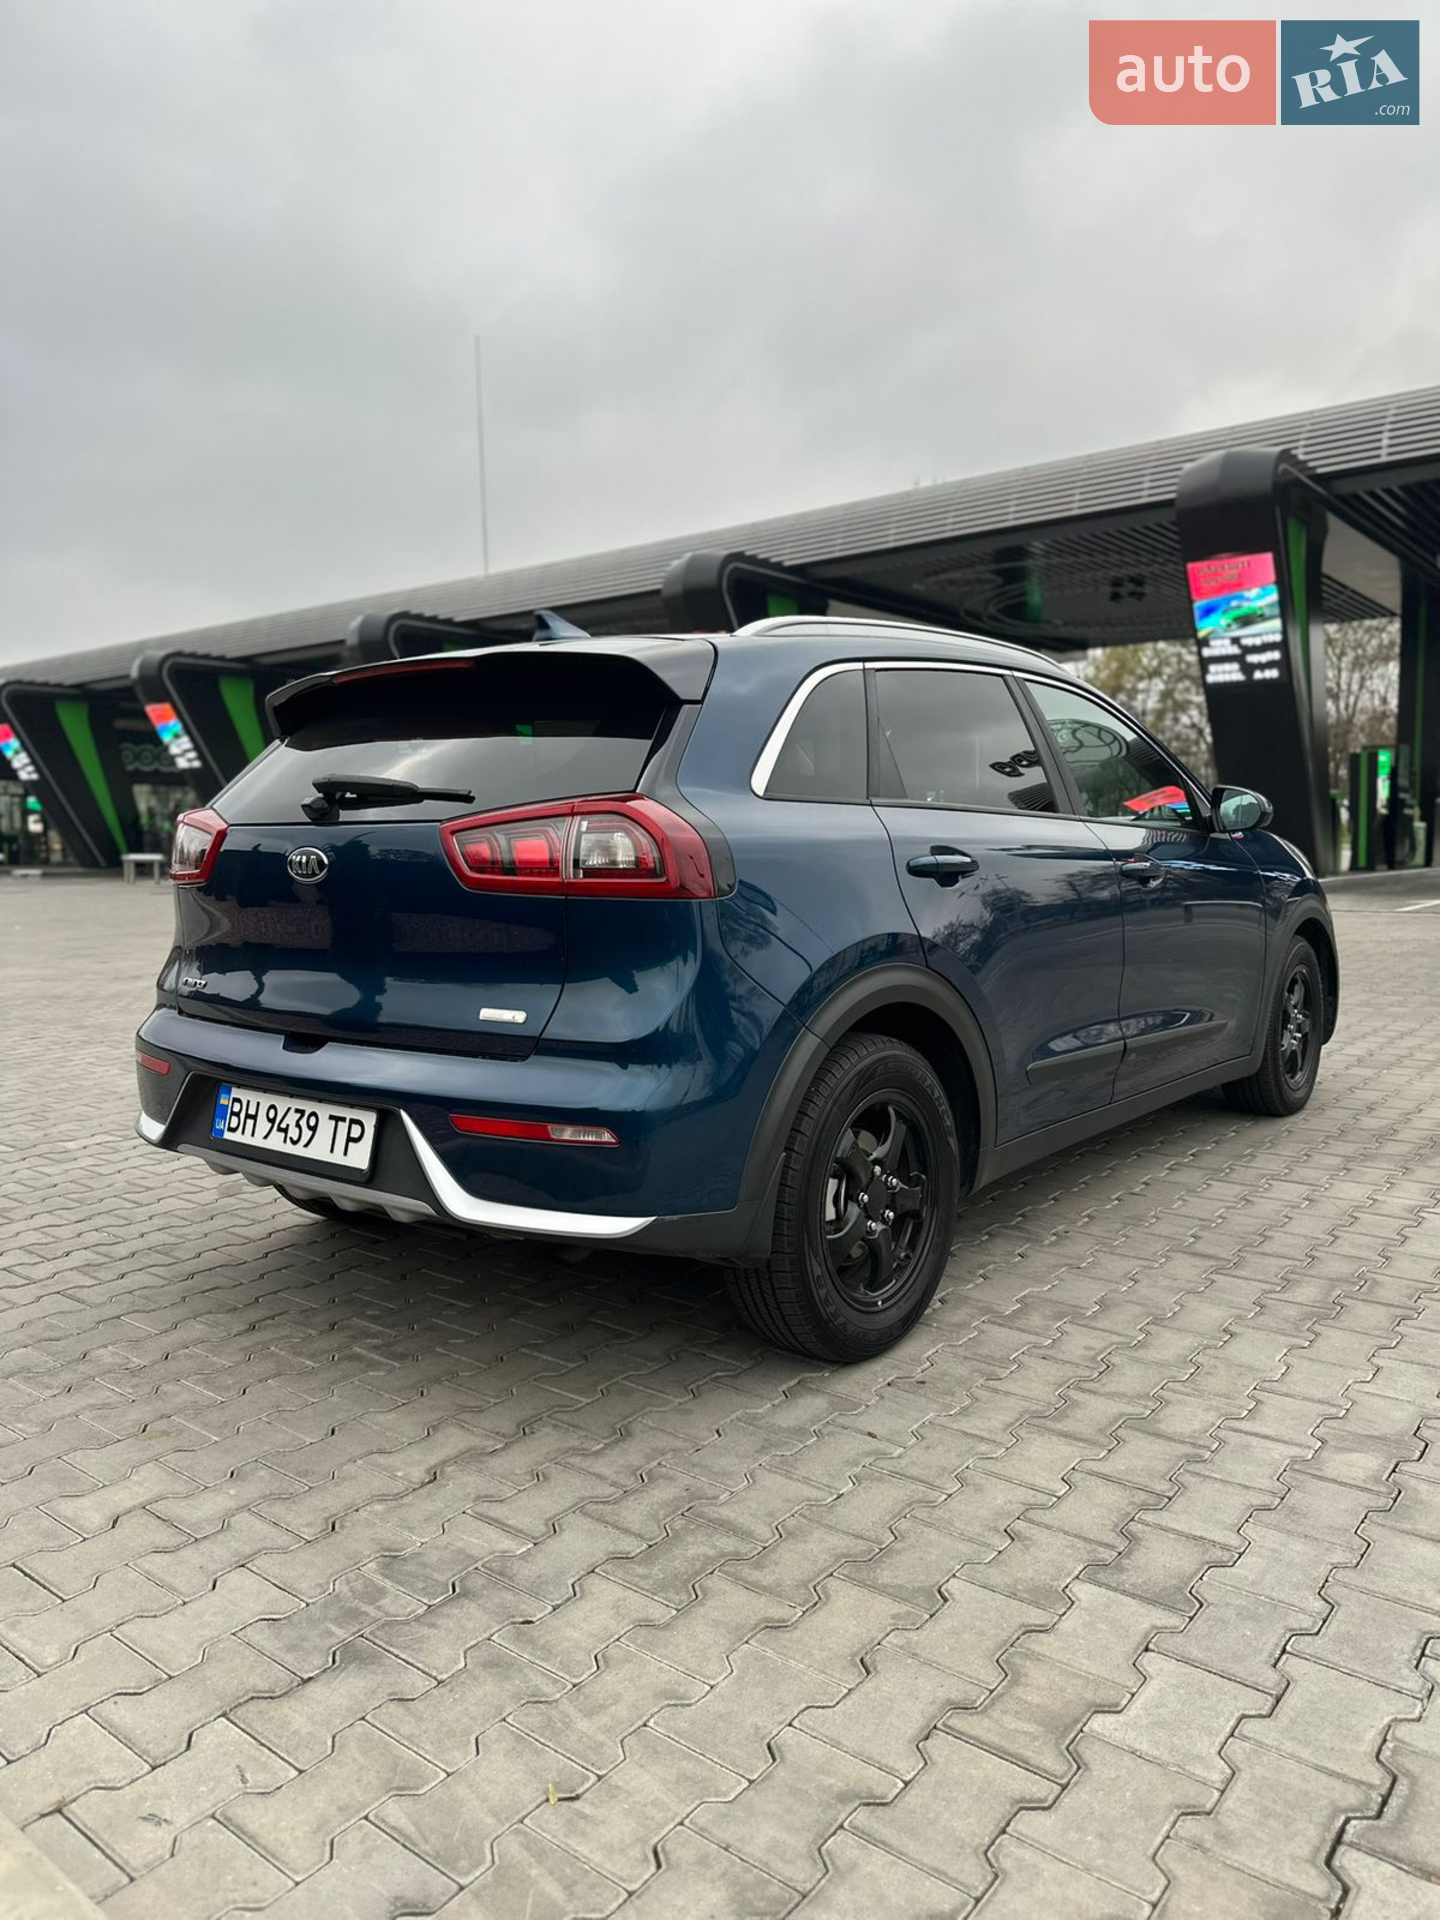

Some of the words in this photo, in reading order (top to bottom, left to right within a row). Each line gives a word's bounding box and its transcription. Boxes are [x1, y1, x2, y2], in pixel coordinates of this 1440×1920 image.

[292, 854, 320, 874] KIA
[215, 1118, 225, 1130] UA
[226, 1096, 261, 1137] BH
[262, 1103, 320, 1148] 9439
[328, 1113, 366, 1157] TP
